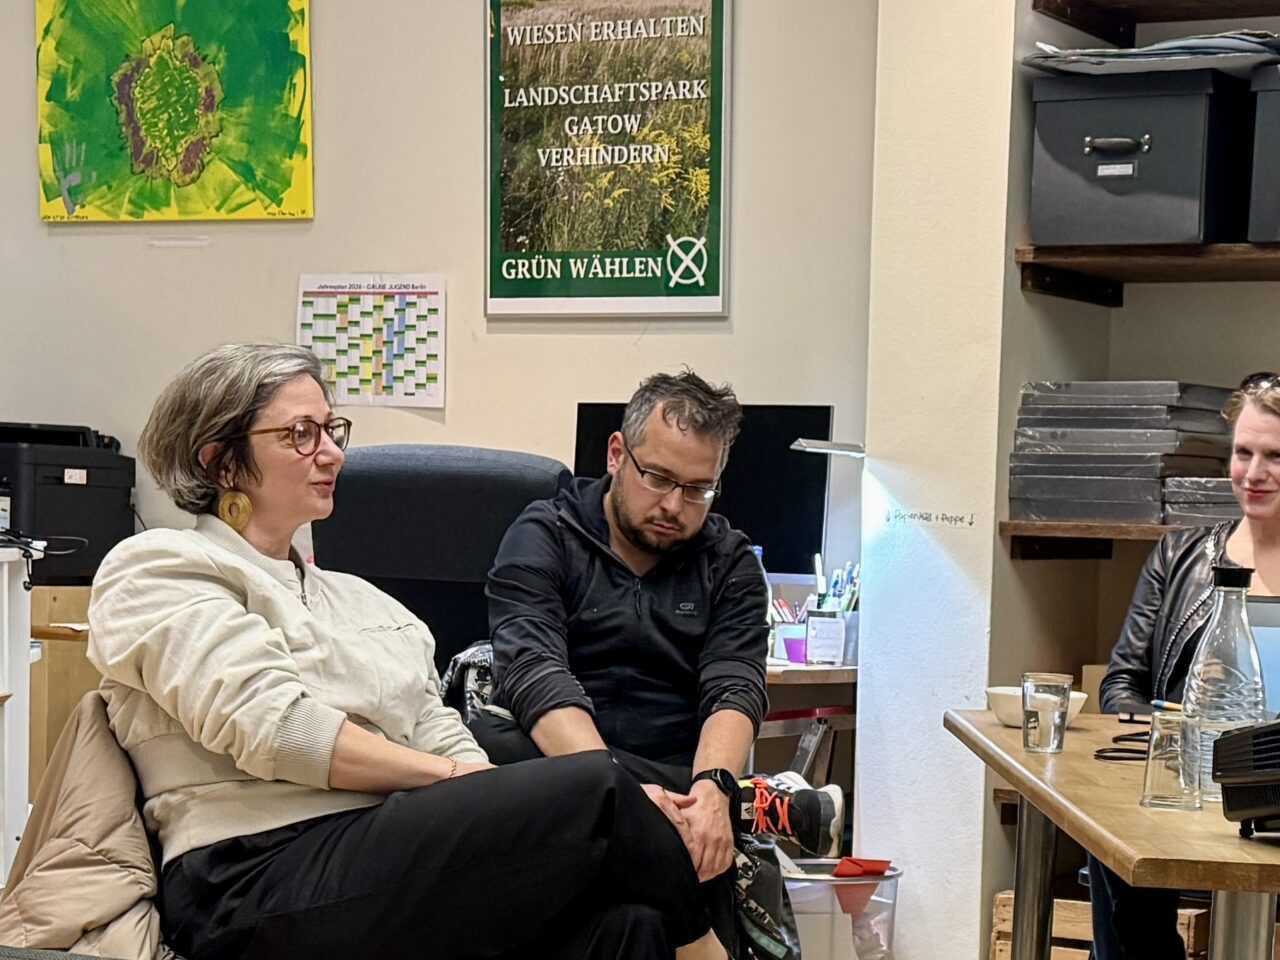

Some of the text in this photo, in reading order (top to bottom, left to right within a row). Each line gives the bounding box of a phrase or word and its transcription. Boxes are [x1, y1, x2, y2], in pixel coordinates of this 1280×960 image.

[506, 16, 706, 46] WIESEN ERHALTEN
[504, 80, 708, 107] LANDSCHAFTSPARK
[564, 114, 642, 136] GATOW
[537, 144, 670, 167] VERHINDERN
[501, 254, 663, 279] GRÜN WÄHLEN
